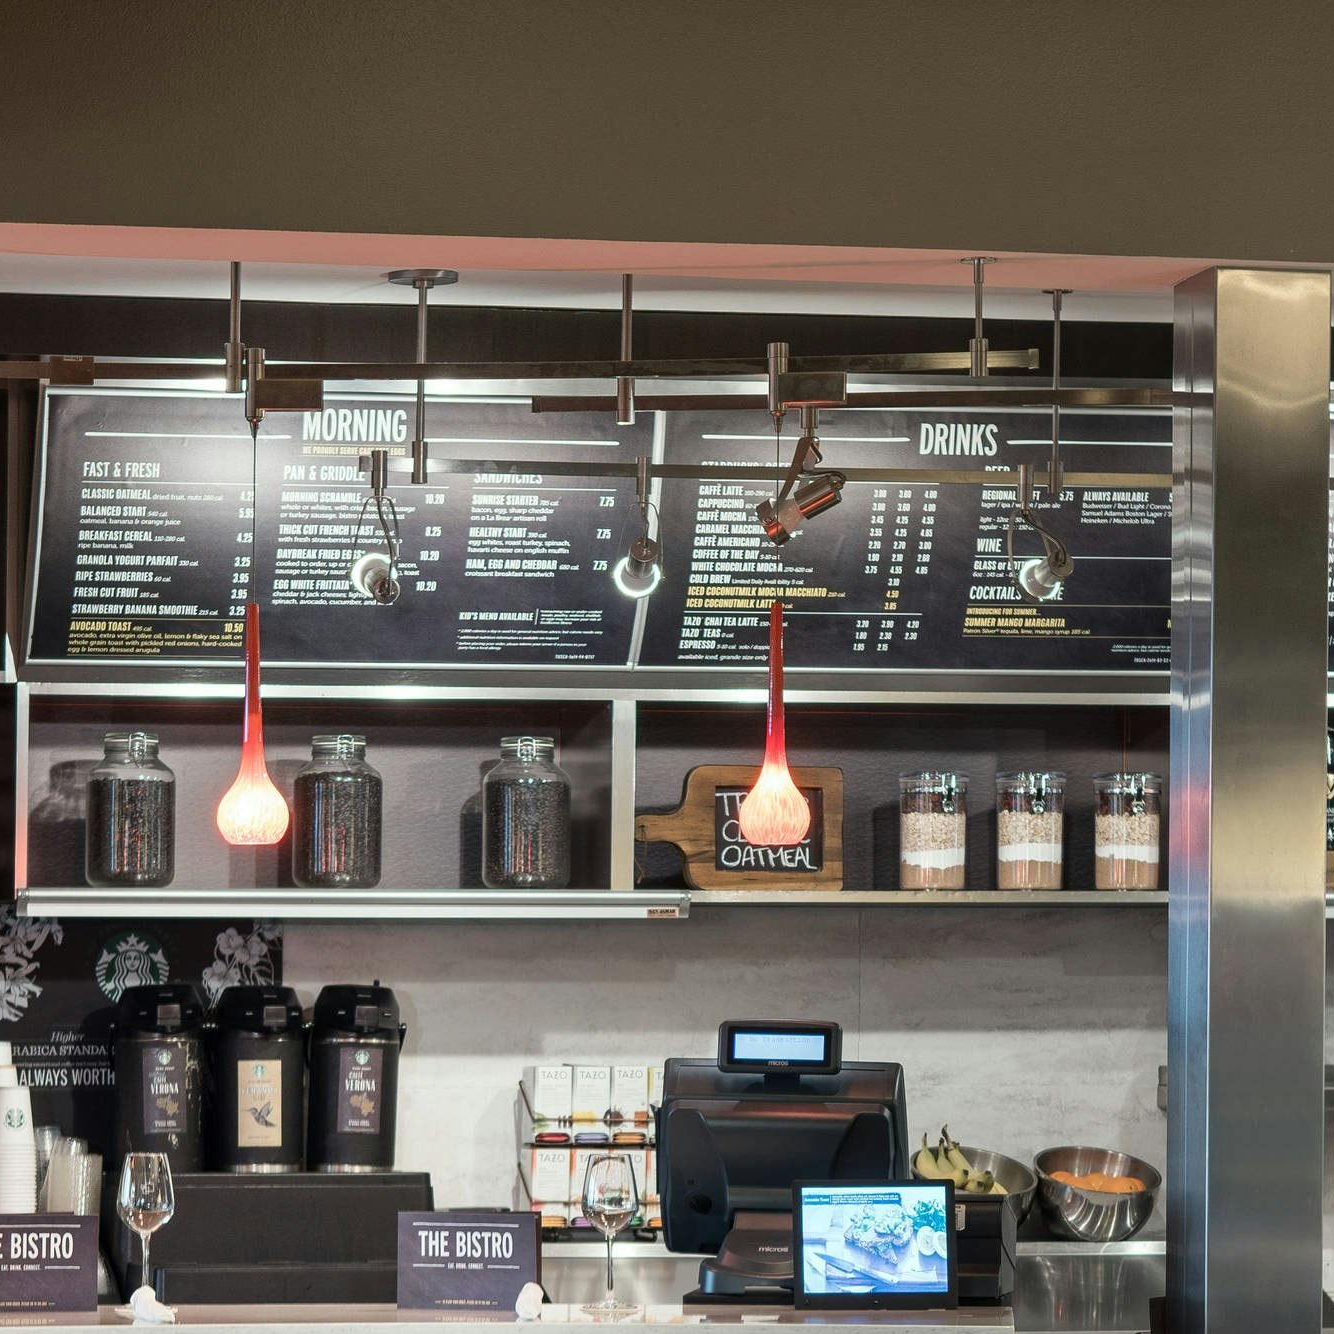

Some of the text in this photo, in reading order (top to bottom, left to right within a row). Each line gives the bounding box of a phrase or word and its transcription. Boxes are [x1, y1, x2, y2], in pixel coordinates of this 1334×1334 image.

[302, 409, 407, 442] MORNING
[919, 423, 999, 456] DRINKS
[83, 462, 110, 477] FAST
[125, 463, 160, 478] FRESH
[283, 466, 306, 480] PAN
[82, 488, 151, 500] CLASSIC OATMEAL
[723, 486, 743, 496] LATTE
[1083, 491, 1149, 502] ALWAYS AVAILABLE
[81, 506, 147, 516] BALANCED START
[279, 524, 318, 535] THICK CUT
[504, 528, 527, 538] START
[79, 531, 153, 541] BREAKFAST CEREAL
[717, 537, 760, 547] AMERICANO
[977, 538, 1003, 552] WINE
[77, 555, 178, 566] GRANOLA YOGURT PARFAIT
[235, 557, 251, 568] 3.25
[691, 562, 756, 572] WHITE CHOCOLATE
[75, 571, 153, 582] RIPE STRAWBERRIES
[233, 573, 249, 584] 3.95
[689, 574, 731, 584] COLD BREW
[291, 580, 315, 590] WHITE
[74, 587, 139, 598] FRESH CUT FRUIT
[231, 589, 248, 600] 3.95
[688, 587, 827, 597] ICED COCONUTMILK MACCHIATO
[686, 599, 703, 608] ICED
[72, 604, 198, 615] STRAWBERRY BANANA SMOOTHIE
[229, 606, 246, 616] 3.25
[70, 622, 132, 632] AVOCADO TOAST
[224, 623, 244, 632] 10.50
[965, 618, 1023, 627] SUMMER MANGO
[680, 640, 715, 649] ESPRESSO
[721, 845, 818, 869] OATMEAL
[51, 1031, 85, 1043] Higher
[19, 1068, 115, 1086] ALWAYS WORTH
[541, 1071, 567, 1080] TAZO
[579, 1071, 606, 1080] TAZO
[617, 1070, 643, 1079] TAZO
[150, 1084, 179, 1095] VERONA
[345, 1080, 376, 1092] VERONA
[539, 1153, 565, 1162] TAZO
[10, 1232, 74, 1260] BISTRO
[418, 1230, 513, 1259] THE BISTRO
